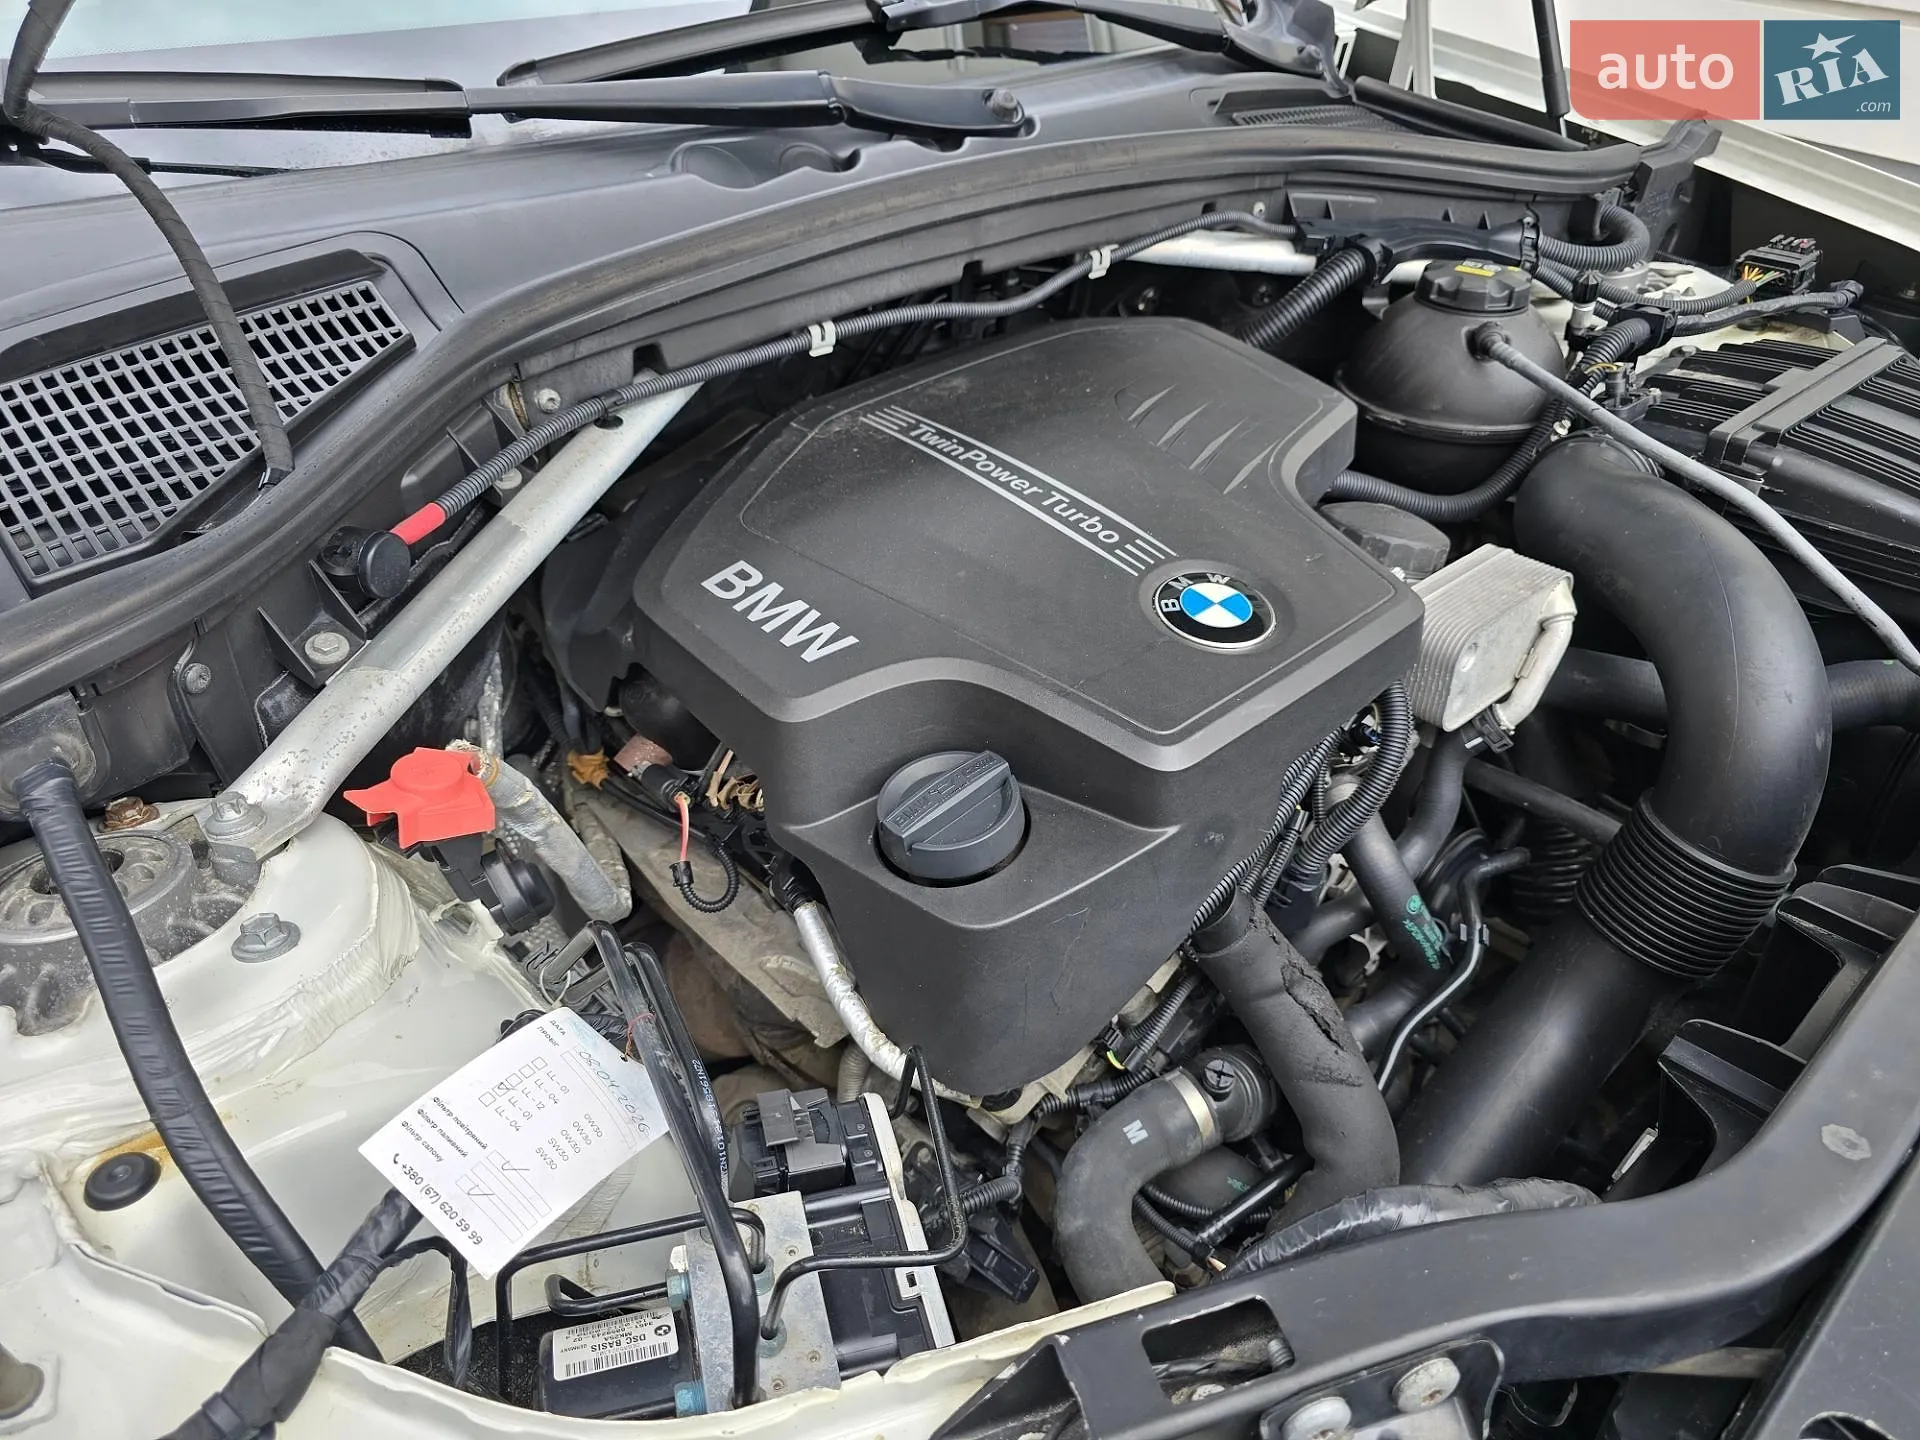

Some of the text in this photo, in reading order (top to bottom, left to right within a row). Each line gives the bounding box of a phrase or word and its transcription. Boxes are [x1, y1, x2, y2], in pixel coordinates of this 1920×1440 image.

[908, 423, 1120, 544] TwinPower Turbo
[700, 559, 860, 663] BMW
[1160, 573, 1231, 612] BMW
[433, 1096, 453, 1118] Фільтр
[401, 1120, 444, 1163] Фільтр салону
[417, 1108, 469, 1158] Фільтр паливний
[401, 1163, 483, 1246] +380 (67) 620 59 99
[590, 1339, 622, 1353] BASIS
[625, 1333, 647, 1345] DSC
